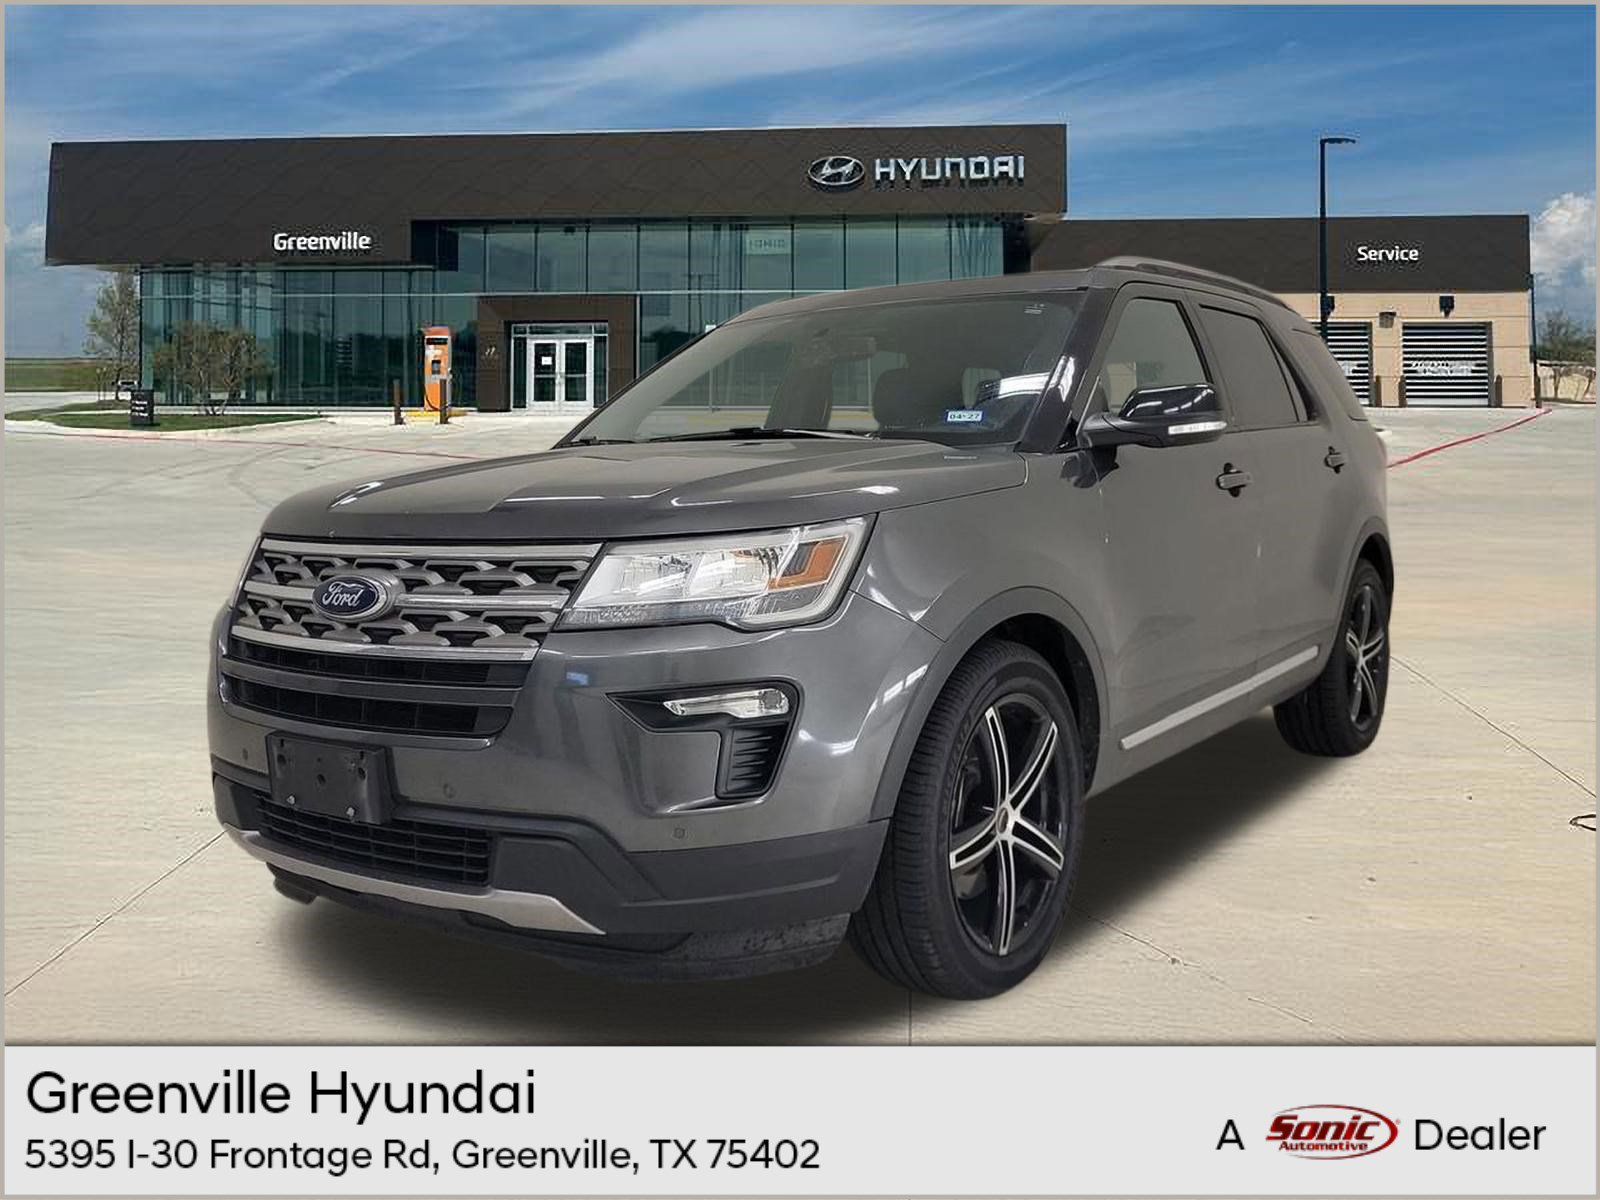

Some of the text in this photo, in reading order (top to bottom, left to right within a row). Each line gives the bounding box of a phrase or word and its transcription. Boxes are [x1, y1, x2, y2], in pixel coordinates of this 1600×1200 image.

[875, 155, 1025, 181] HYUNDAI
[273, 231, 371, 251] Greenville
[1356, 244, 1419, 262] Service
[322, 581, 365, 607] Ford
